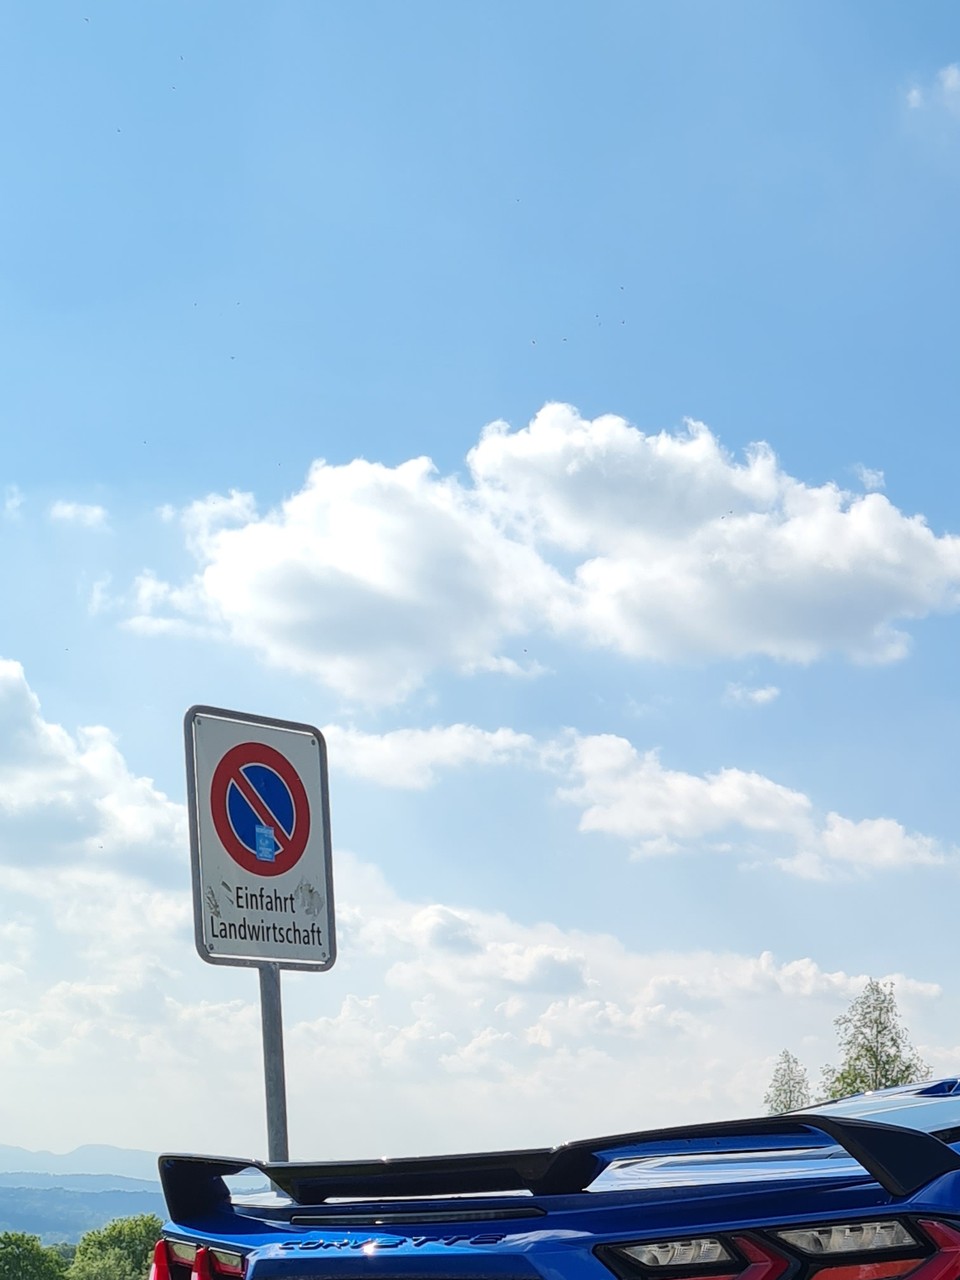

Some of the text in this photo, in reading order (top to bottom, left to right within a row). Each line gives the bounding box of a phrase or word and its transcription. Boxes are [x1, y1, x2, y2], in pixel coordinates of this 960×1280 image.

[236, 886, 296, 914] Einfahrt
[210, 915, 323, 946] Landwirtschaft
[279, 1233, 507, 1250] CORVETTE
